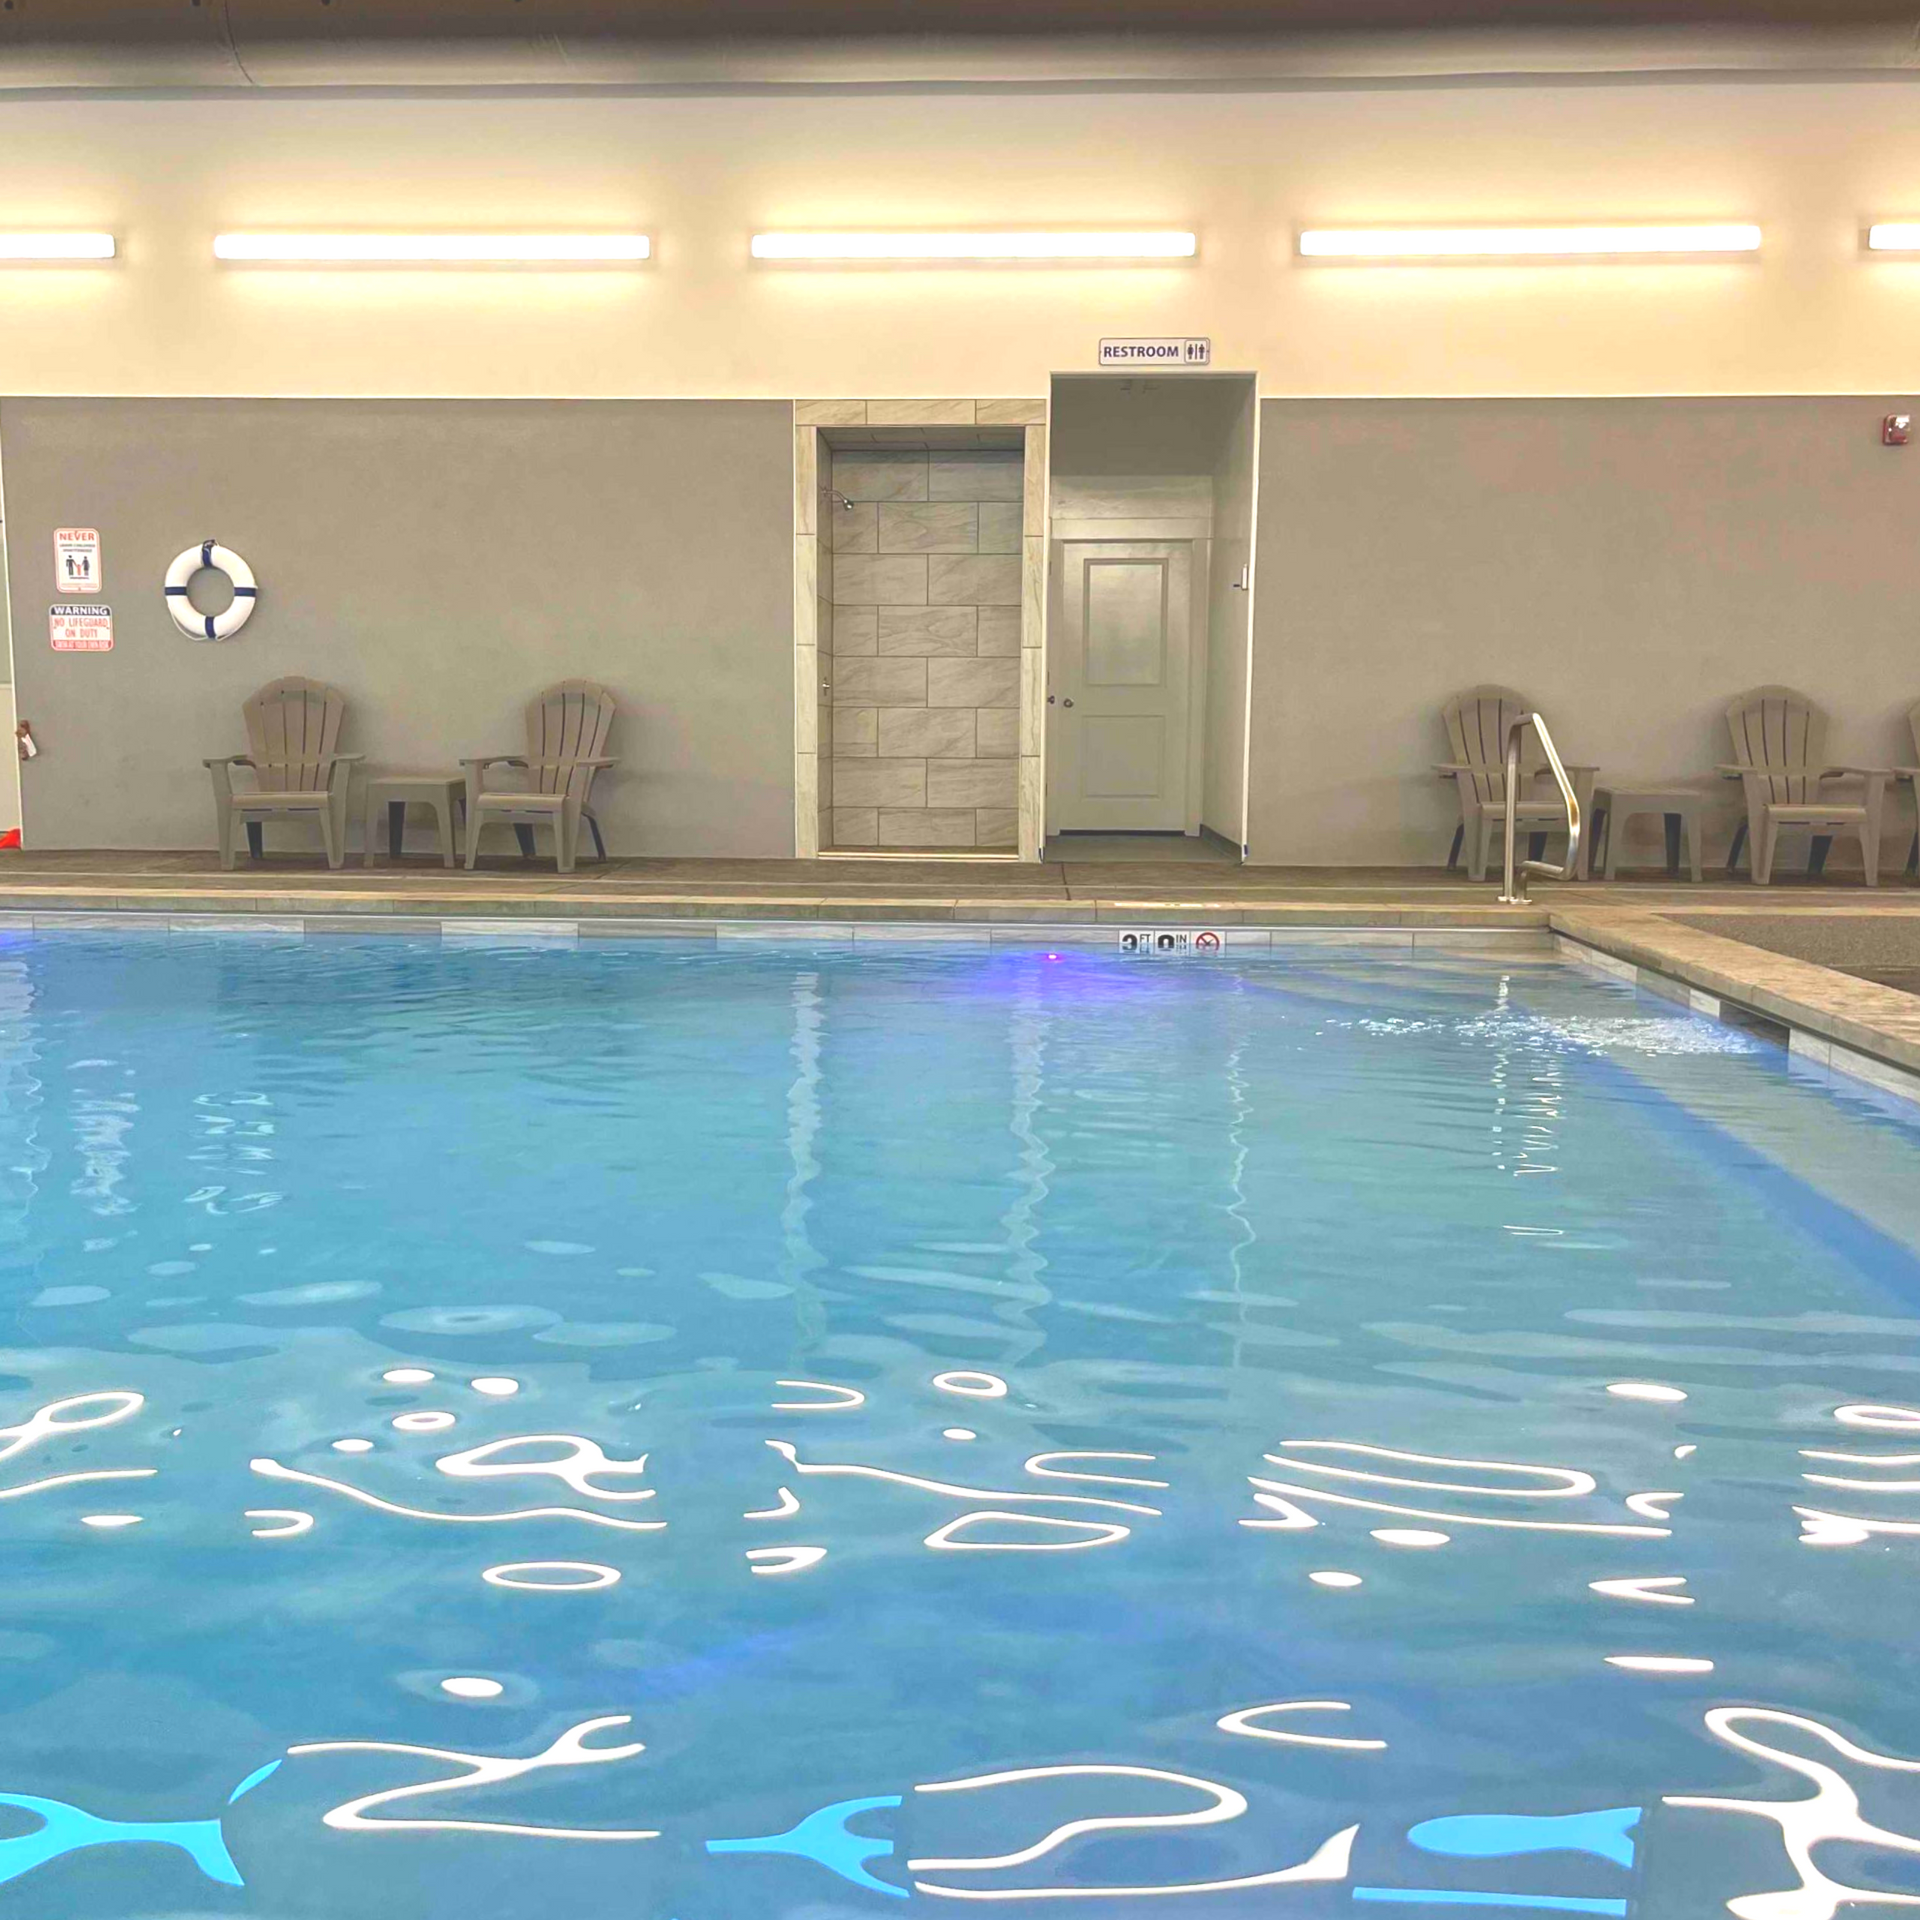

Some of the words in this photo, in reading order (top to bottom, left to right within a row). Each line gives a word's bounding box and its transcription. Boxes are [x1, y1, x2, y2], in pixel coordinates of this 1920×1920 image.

[1103, 346, 1179, 357] RESTROOM
[59, 532, 95, 541] NEVER
[54, 606, 108, 615] WARNING
[54, 617, 65, 627] NO
[69, 617, 108, 627] LIFEGUARD
[65, 628, 76, 638] ON
[80, 628, 98, 638] DUTY
[1140, 934, 1151, 943] FT
[1176, 934, 1187, 943] IN
